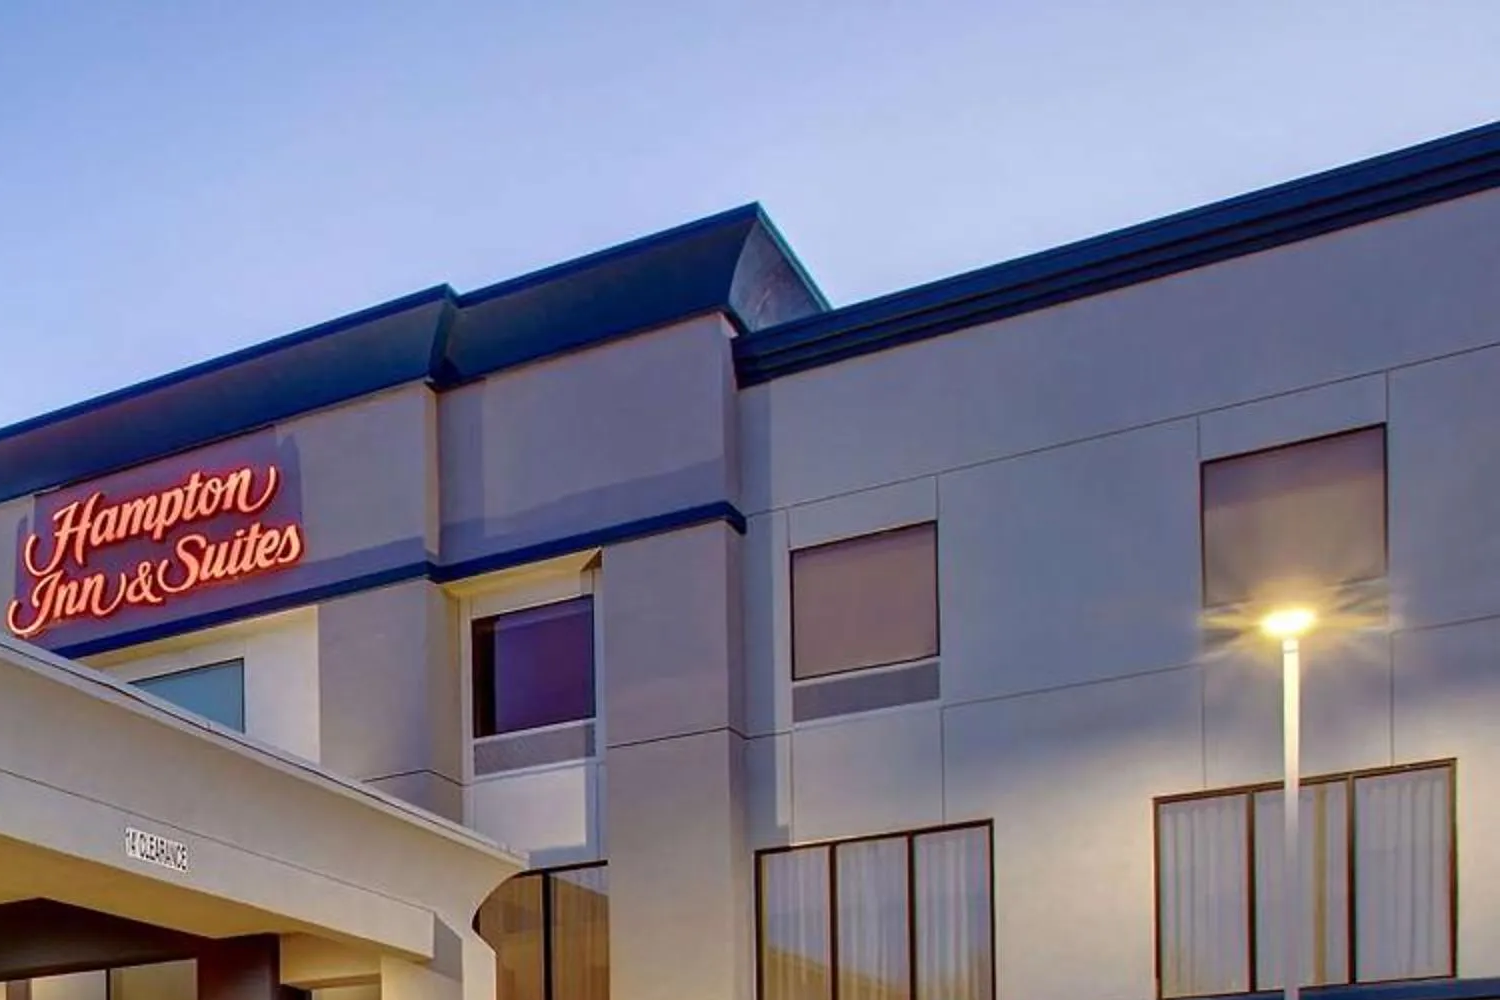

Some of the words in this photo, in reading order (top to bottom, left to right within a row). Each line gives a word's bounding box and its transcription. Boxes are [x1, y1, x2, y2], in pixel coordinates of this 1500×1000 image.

[25, 465, 277, 577] Hampton
[7, 568, 127, 636] Inn
[125, 560, 165, 603] &
[157, 523, 302, 593] Suites
